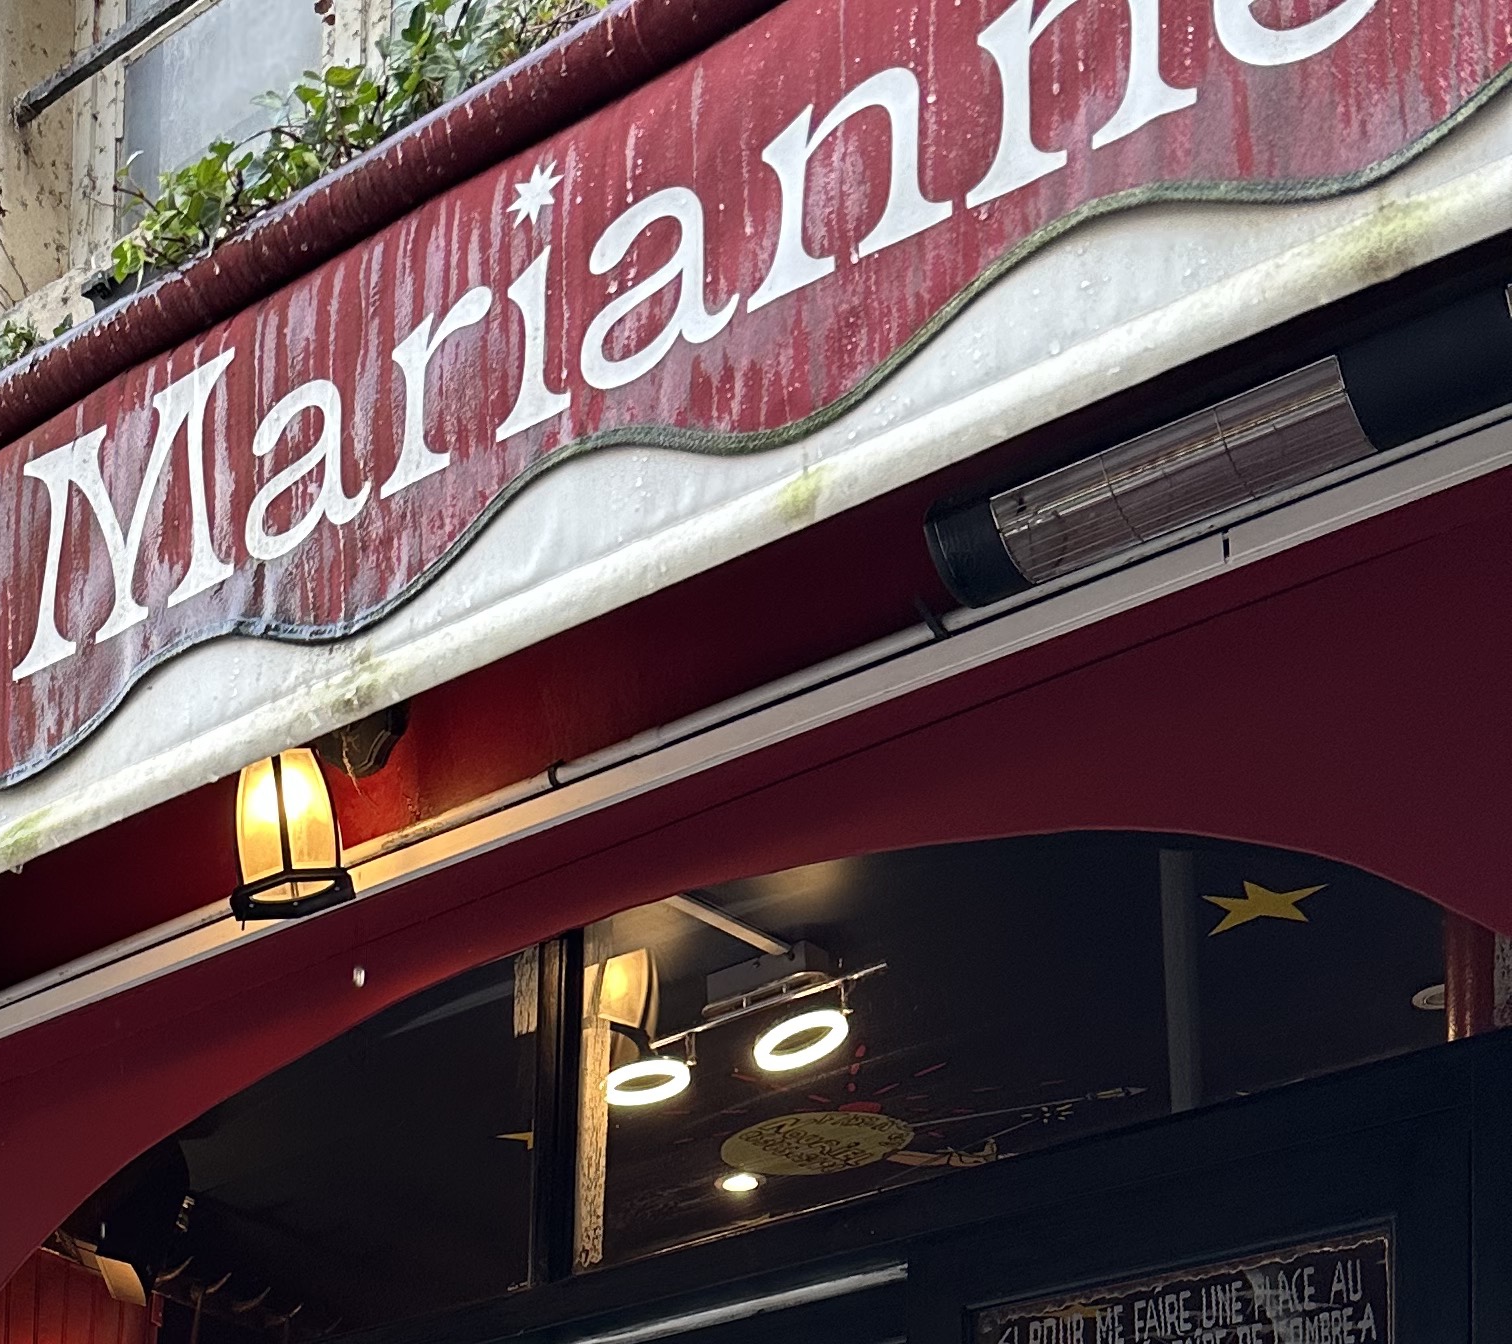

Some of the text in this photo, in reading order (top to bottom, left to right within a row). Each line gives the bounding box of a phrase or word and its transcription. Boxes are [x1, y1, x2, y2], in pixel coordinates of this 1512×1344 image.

[12, 0, 1378, 682] Mariann
[1134, 1286, 1193, 1344] FAIRE
[1202, 1281, 1244, 1329] UNE
[1254, 1267, 1318, 1321] PLACE
[1329, 1259, 1363, 1304] AU
